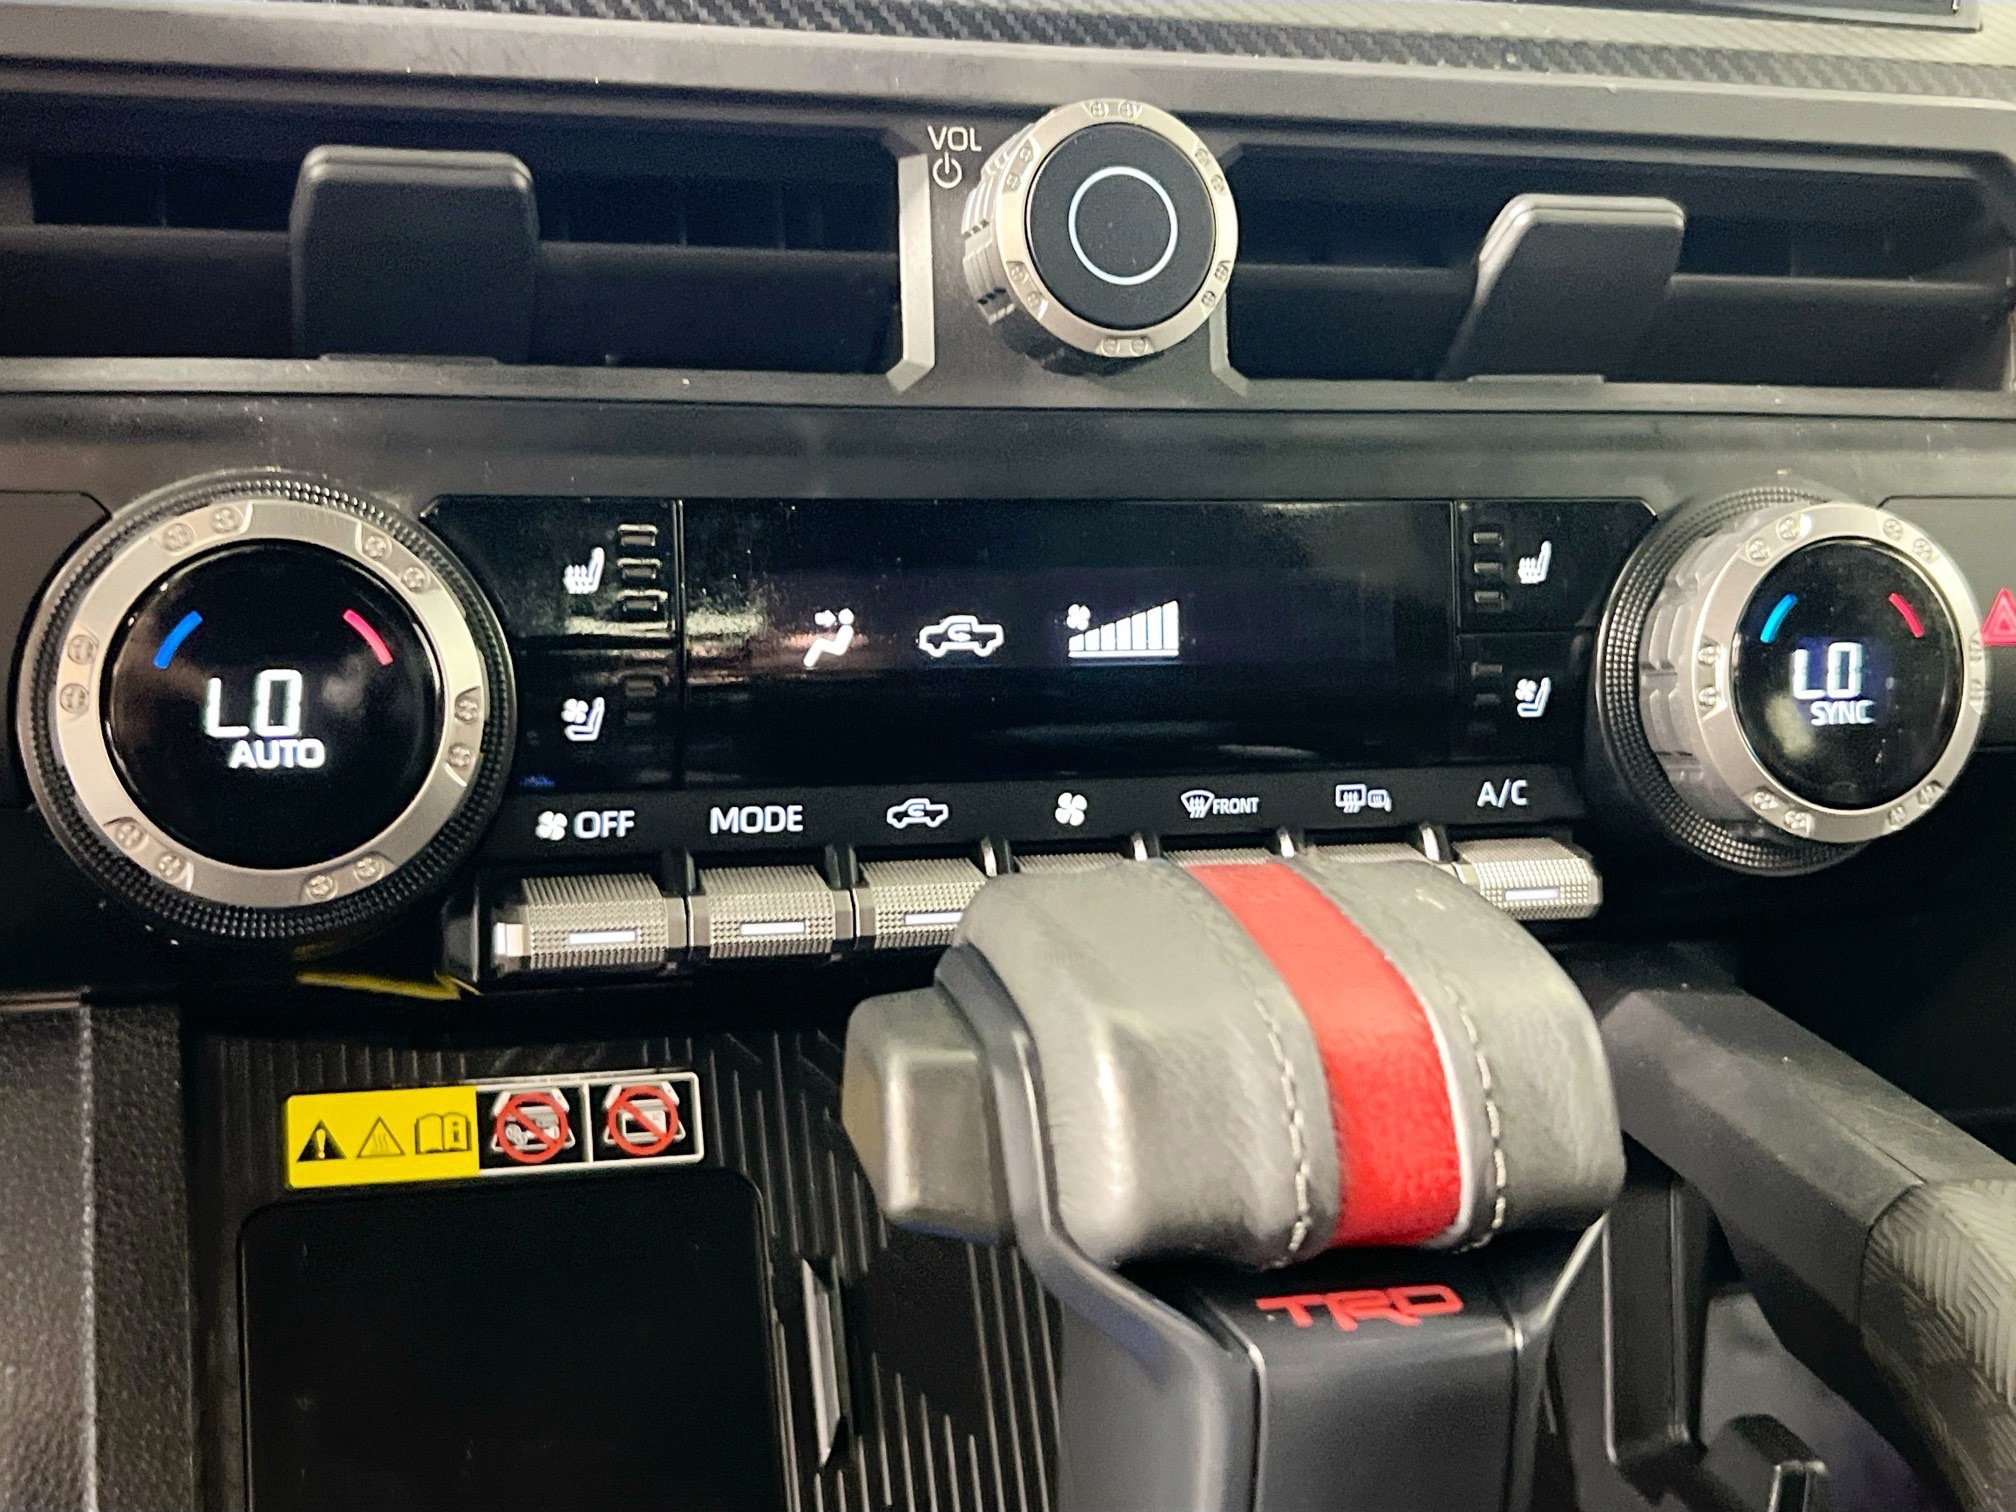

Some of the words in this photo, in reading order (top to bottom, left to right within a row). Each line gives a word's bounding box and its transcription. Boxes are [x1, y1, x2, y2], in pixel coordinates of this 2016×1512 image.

[927, 125, 982, 152] VOL
[1810, 699, 1876, 727] SYNC
[228, 738, 326, 770] AUTO
[1212, 797, 1260, 815] FRONT
[1476, 778, 1529, 808] A/C
[574, 810, 635, 839] OFF
[709, 804, 804, 834] MODE
[1254, 1284, 1465, 1332] TRD
